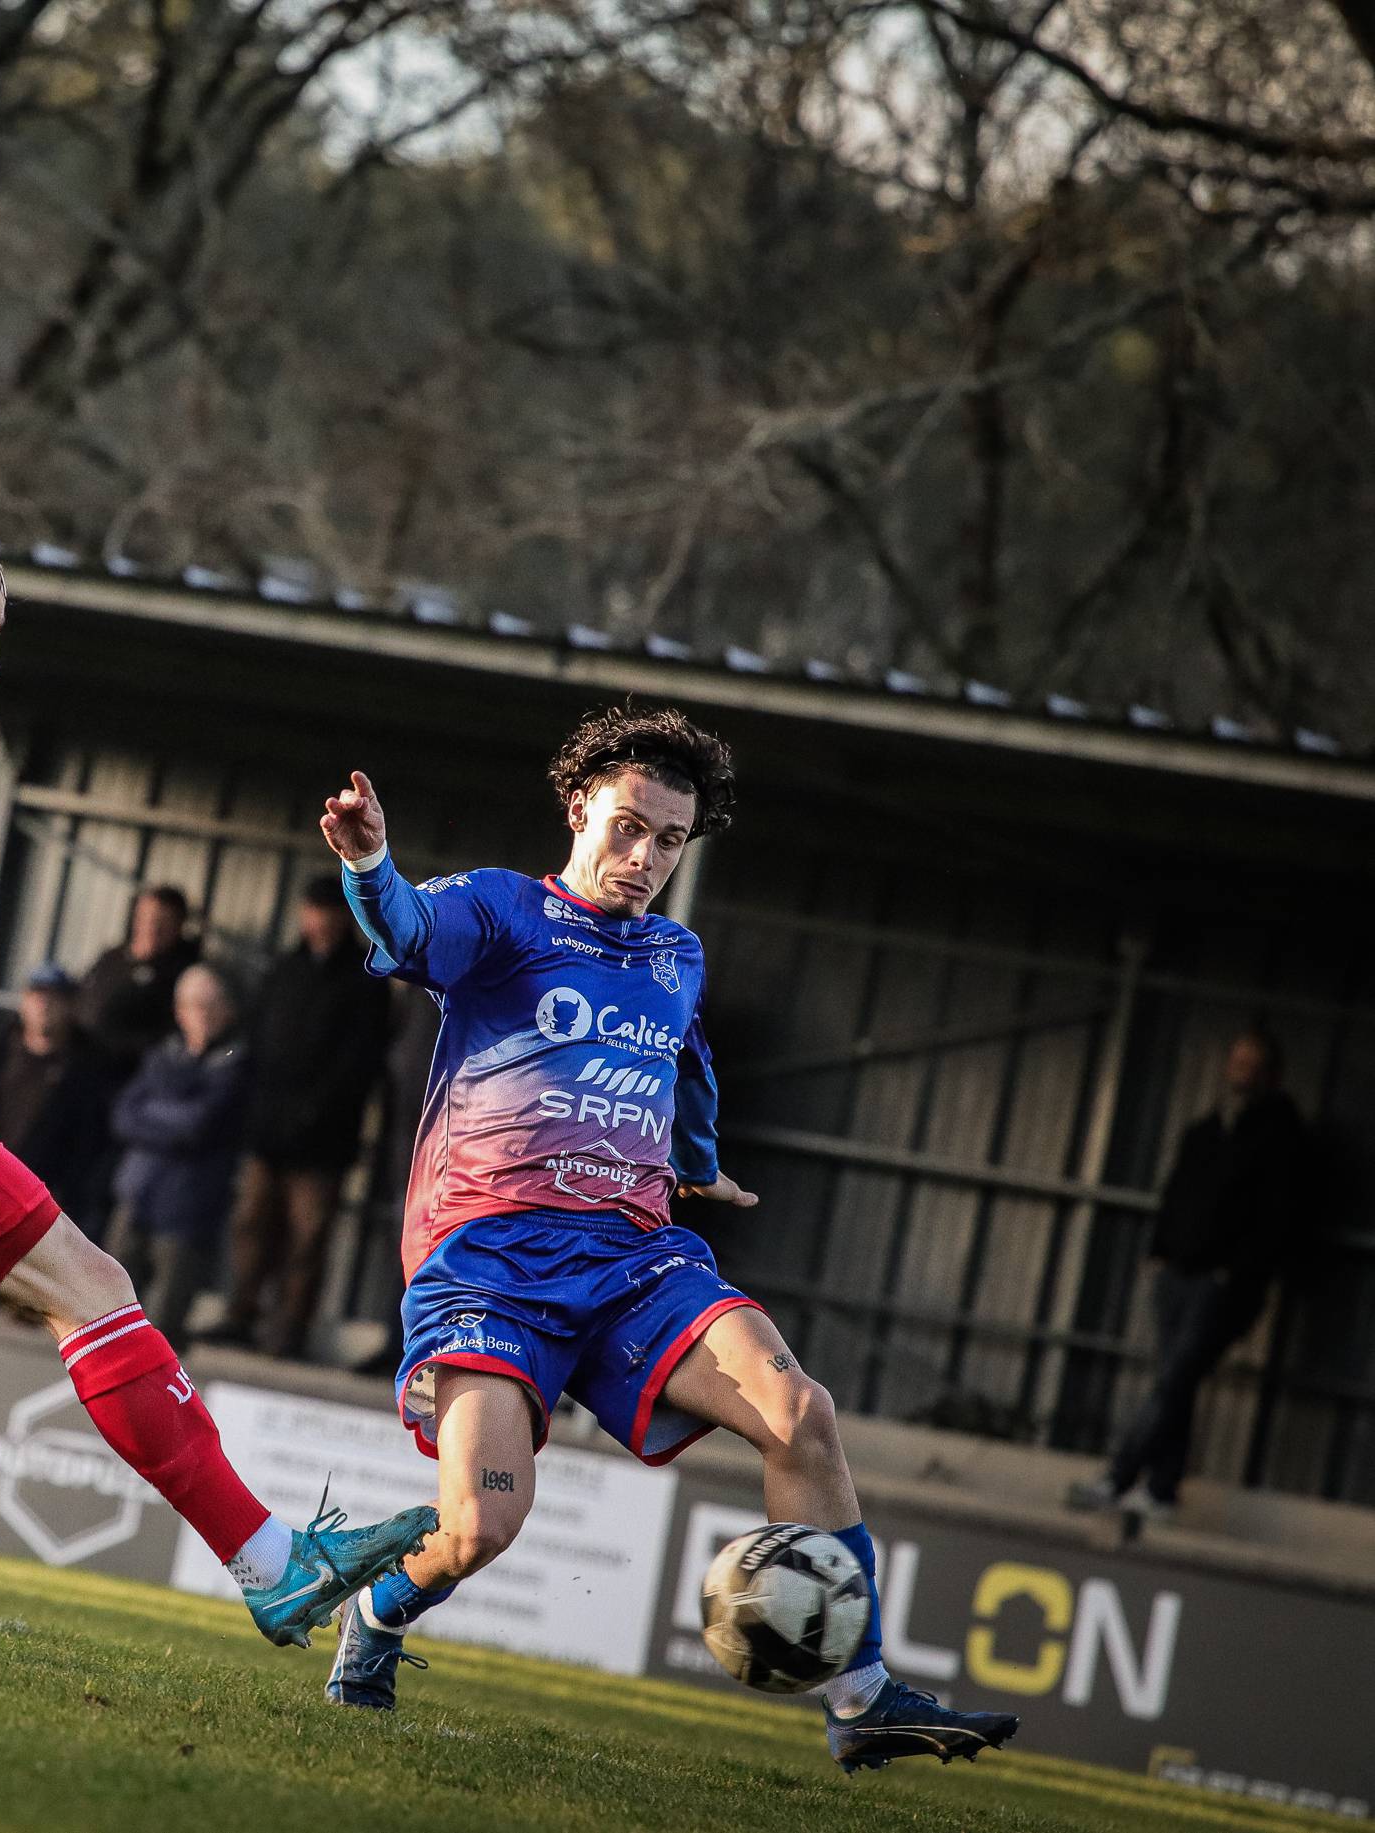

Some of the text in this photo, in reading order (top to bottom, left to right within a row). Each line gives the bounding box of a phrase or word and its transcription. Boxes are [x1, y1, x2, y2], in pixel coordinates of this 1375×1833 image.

[597, 1005, 685, 1055] Caliéc
[606, 1038, 628, 1051] BELLE
[536, 1089, 667, 1145] SRPN
[480, 1467, 515, 1493] 1981
